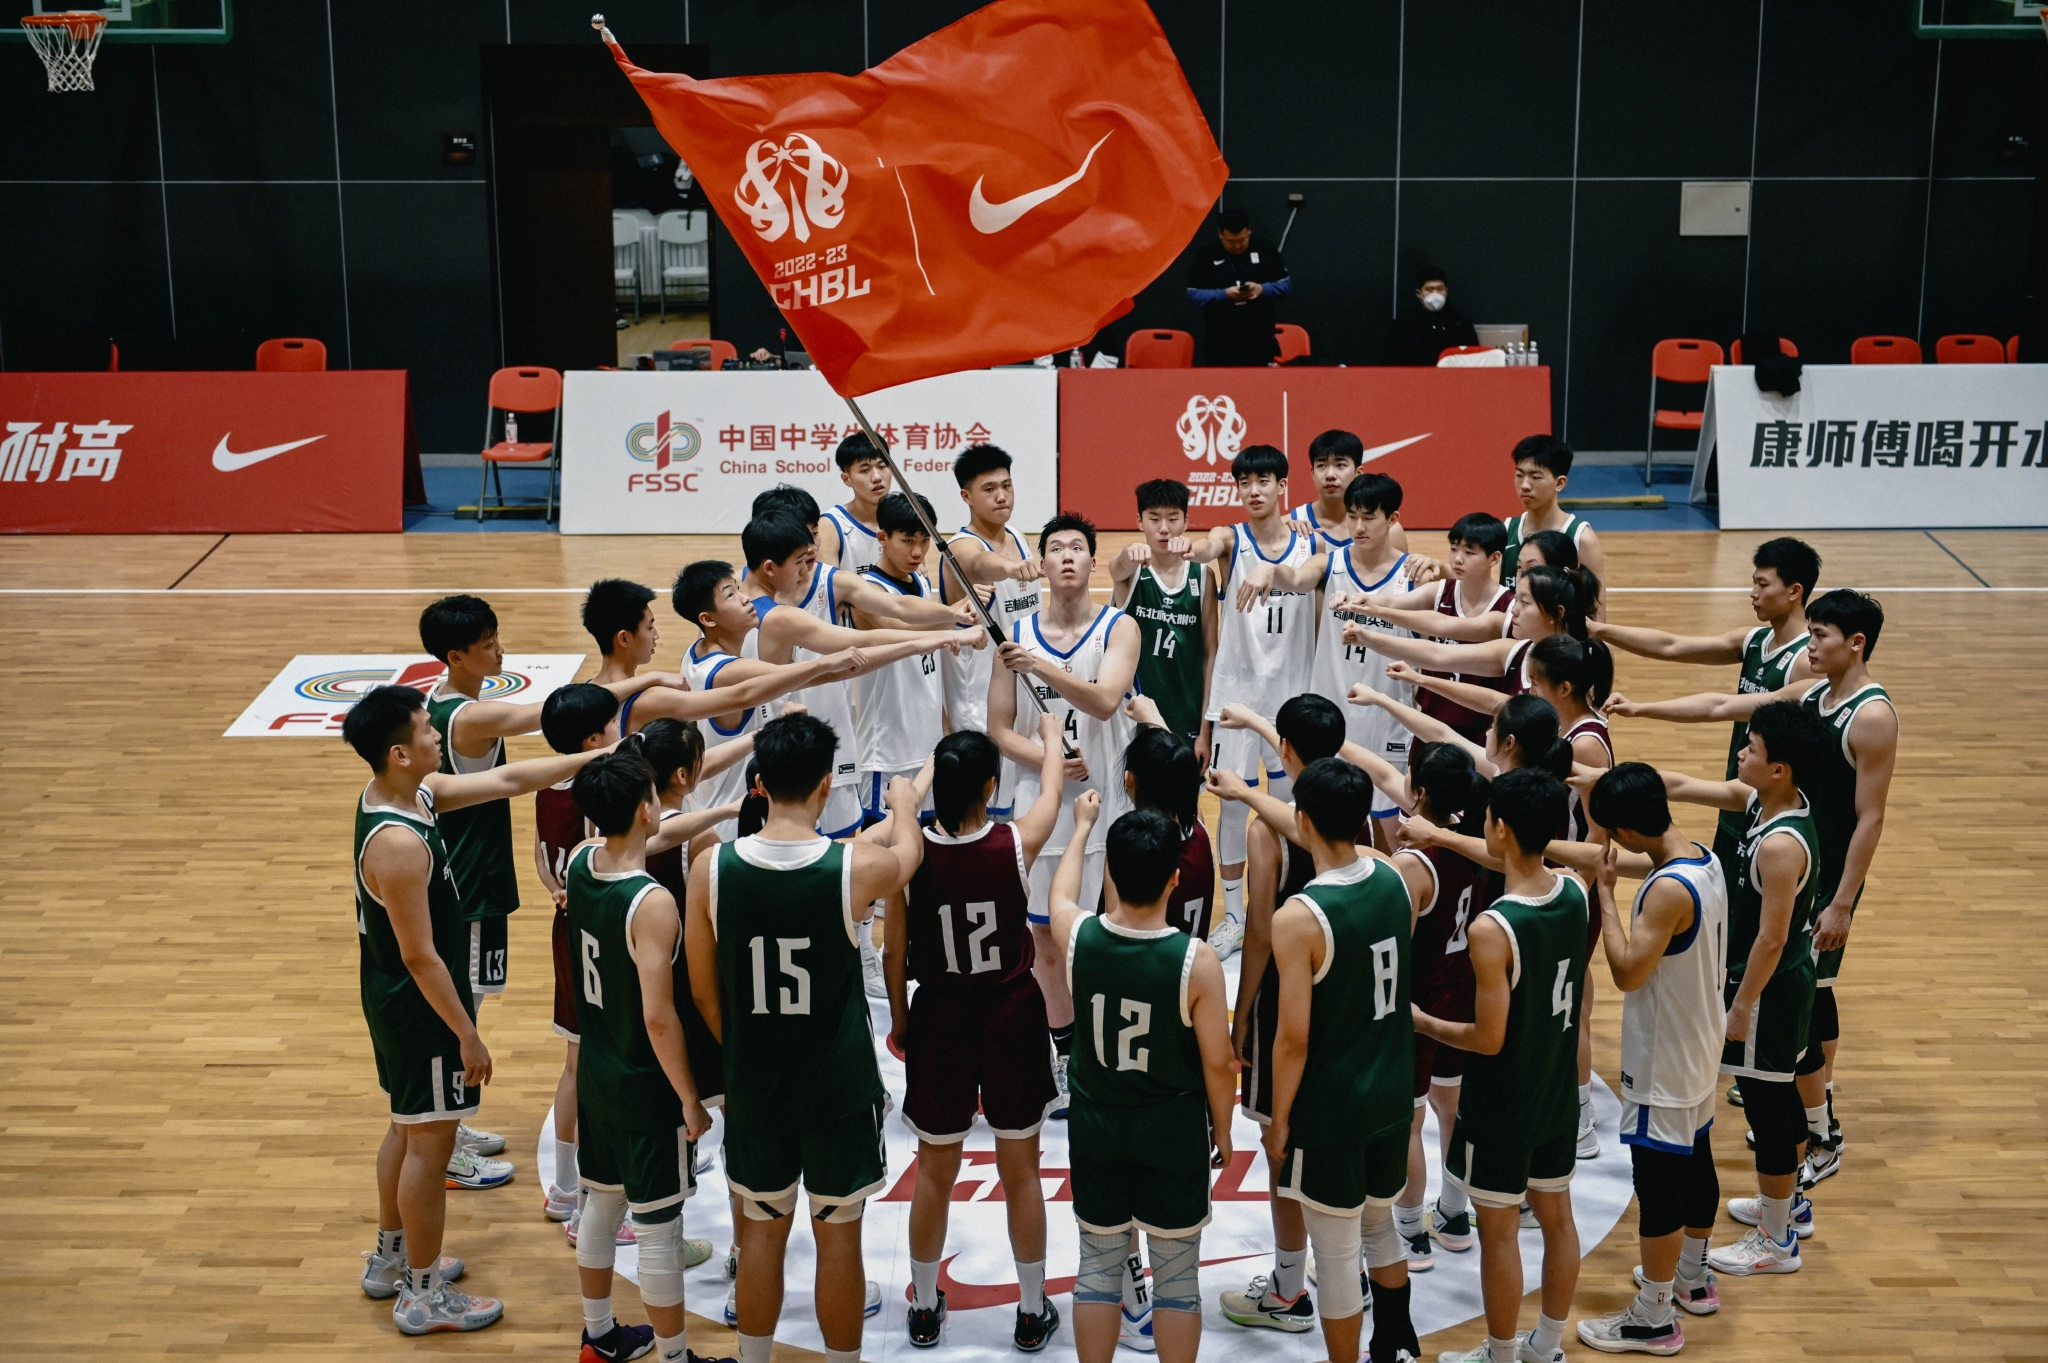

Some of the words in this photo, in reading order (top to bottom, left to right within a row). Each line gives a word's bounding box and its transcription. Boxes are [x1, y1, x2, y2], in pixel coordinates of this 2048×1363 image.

[774, 244, 848, 279] 2022-23
[768, 264, 871, 310] CHBL
[0, 419, 135, 483] 耐高
[720, 460, 767, 474] China
[775, 457, 831, 474] School
[628, 473, 698, 492] FSSC
[1266, 606, 1283, 634] 11
[1152, 628, 1176, 658] 14
[1064, 709, 1078, 740] 4
[937, 900, 1001, 975] 12
[1183, 896, 1204, 938] 7
[1445, 884, 1473, 955] 8
[485, 949, 505, 981] 13
[580, 928, 603, 1010] 6
[748, 935, 811, 1015] 15
[1369, 936, 1399, 1021] 8
[1551, 958, 1574, 1032] 4
[1090, 993, 1152, 1073] 12
[452, 1070, 467, 1105] 9
